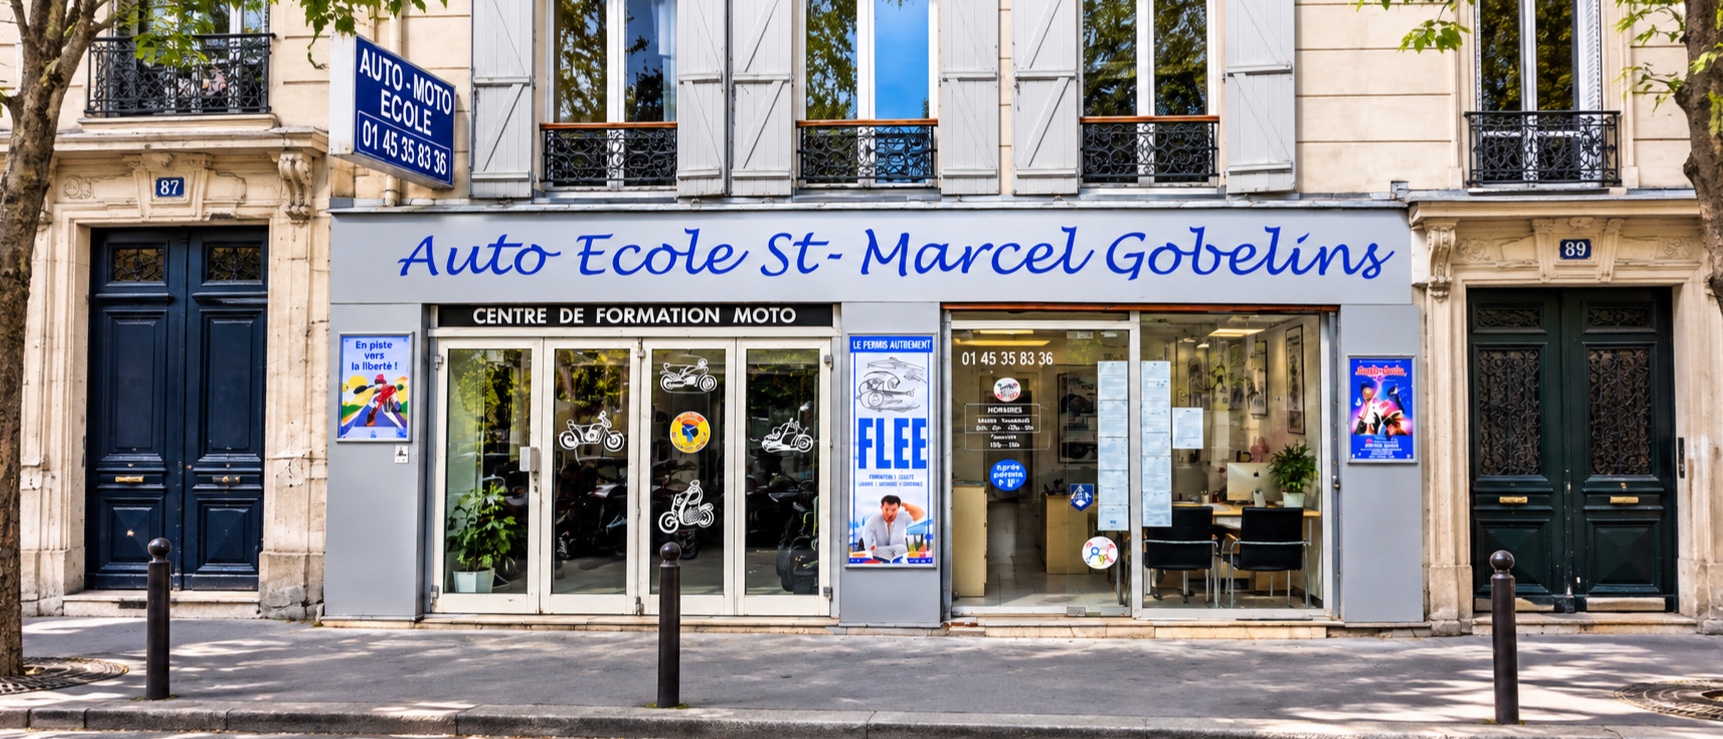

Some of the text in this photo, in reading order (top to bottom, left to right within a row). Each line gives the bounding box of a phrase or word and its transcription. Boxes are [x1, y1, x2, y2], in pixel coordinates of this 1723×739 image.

[359, 47, 403, 92] AUTO
[413, 73, 452, 116] MOTO
[380, 88, 432, 137] ECOLE
[362, 119, 447, 176] 01 45 35 83 36
[160, 181, 178, 196] 87
[398, 233, 561, 277] Auto
[576, 227, 750, 277] Ecole
[860, 225, 1095, 278] Marcel
[1105, 225, 1396, 281] Gobelins
[1565, 242, 1586, 257] 89
[472, 307, 797, 325] CENTRE DE FORMATION MOTO
[355, 340, 393, 352] En piste
[853, 340, 862, 350] LE
[351, 361, 360, 371] la
[961, 351, 1054, 366] 01 45 35 83 36
[858, 417, 927, 469] FLEE
